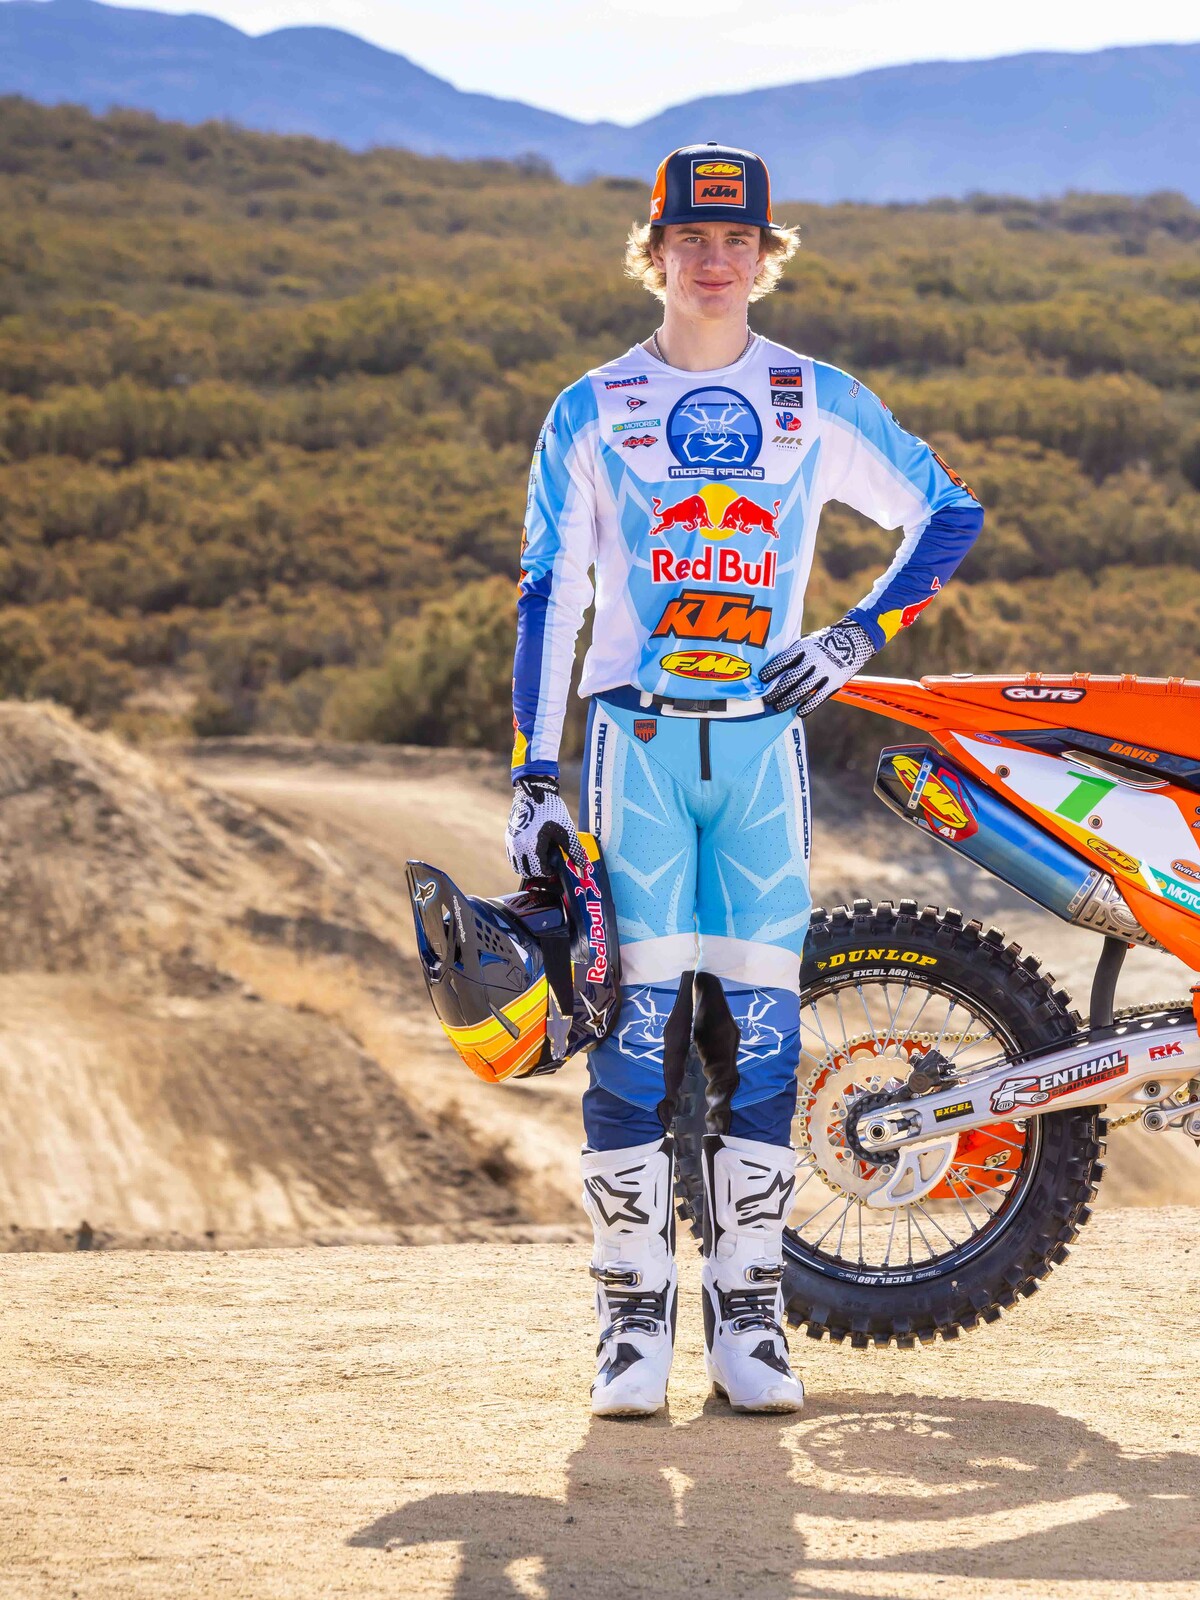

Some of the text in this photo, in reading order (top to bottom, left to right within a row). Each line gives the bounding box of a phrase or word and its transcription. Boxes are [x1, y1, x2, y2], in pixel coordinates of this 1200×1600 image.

[696, 164, 742, 174] FMF
[701, 185, 738, 198] KTM
[624, 420, 658, 429] MOTOREX
[776, 411, 794, 431] VP
[624, 437, 657, 446] IMS
[671, 468, 763, 477] MOOSE RACING
[651, 546, 778, 589] Red Bull
[652, 590, 773, 648] KTM
[661, 654, 751, 675] FMF
[1005, 688, 1083, 701] GUTS
[1108, 742, 1160, 763] DAVIS
[792, 728, 806, 793] RACING
[1174, 862, 1192, 876] Twin
[586, 901, 608, 984] Red Bull
[829, 948, 938, 968] DUNLOP
[853, 968, 887, 978] EXCEL
[888, 968, 909, 977] A60
[1149, 1041, 1184, 1059] RK
[1051, 1066, 1126, 1096] CHAINWHEELS
[936, 1102, 972, 1117] EXCEL
[857, 1275, 878, 1284] A60
[877, 1275, 913, 1284] EXCEL
